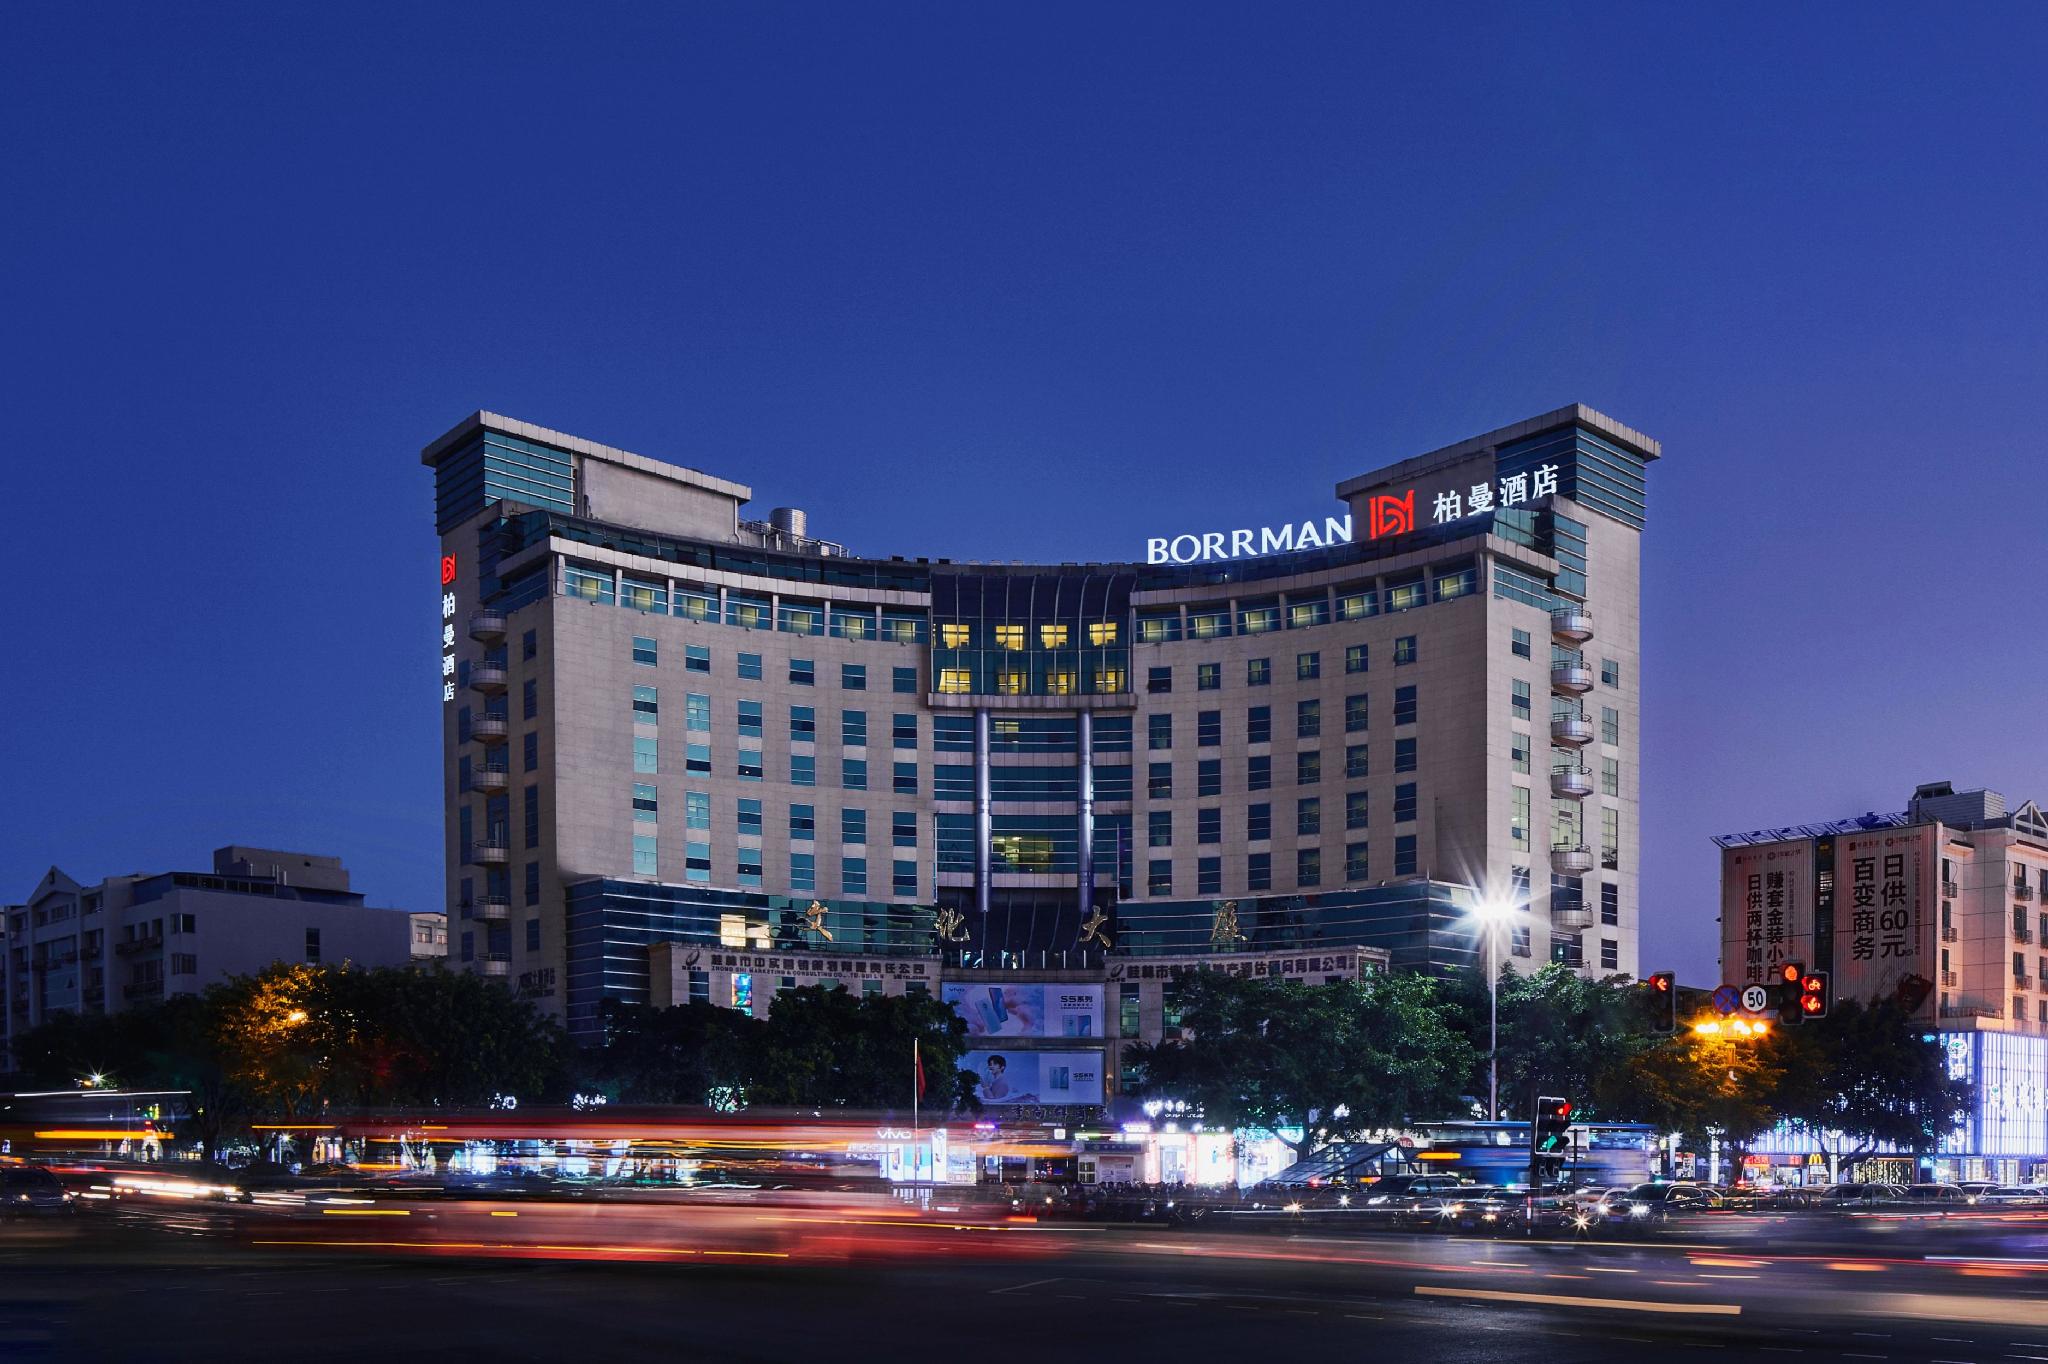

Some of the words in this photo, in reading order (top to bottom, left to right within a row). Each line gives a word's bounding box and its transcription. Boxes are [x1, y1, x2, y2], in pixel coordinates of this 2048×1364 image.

[1146, 513, 1353, 565] BORRMAN
[1433, 463, 1560, 523] 柏曼酒店
[442, 592, 456, 702] 柏曼酒店
[1746, 873, 1763, 983] 日供两杯咖啡
[1766, 871, 1784, 982] 赚套金装小户
[1852, 856, 1876, 961] 百变商务
[1880, 853, 1909, 959] 日供60元
[1747, 990, 1764, 1008] 50
[877, 1128, 912, 1139] vivo
